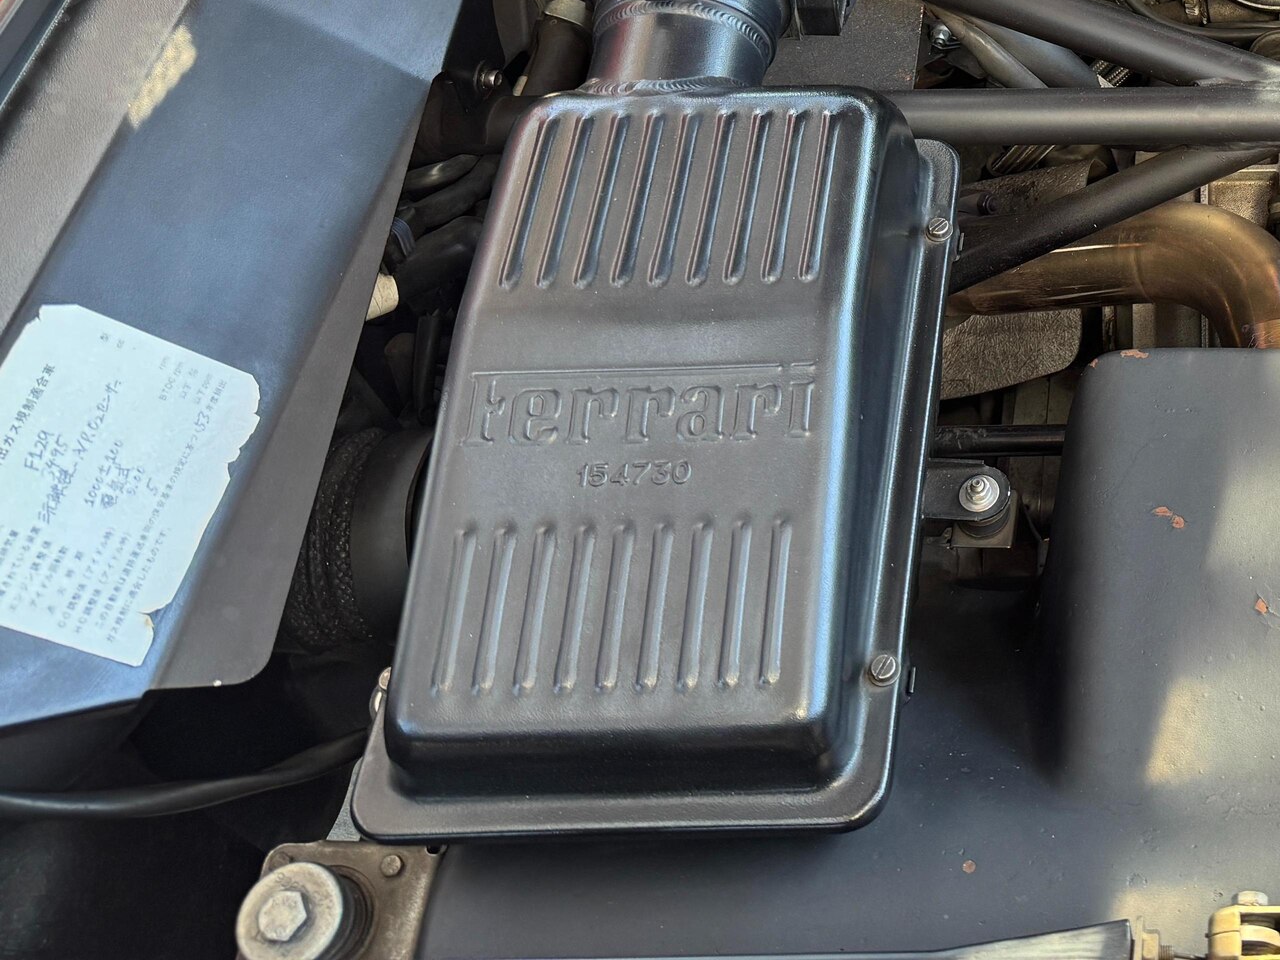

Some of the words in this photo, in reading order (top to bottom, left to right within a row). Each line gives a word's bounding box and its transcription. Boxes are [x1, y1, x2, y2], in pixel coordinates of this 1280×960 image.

[459, 361, 817, 446] Ferrari
[20, 427, 57, 473] F129
[576, 459, 693, 488] 154730
